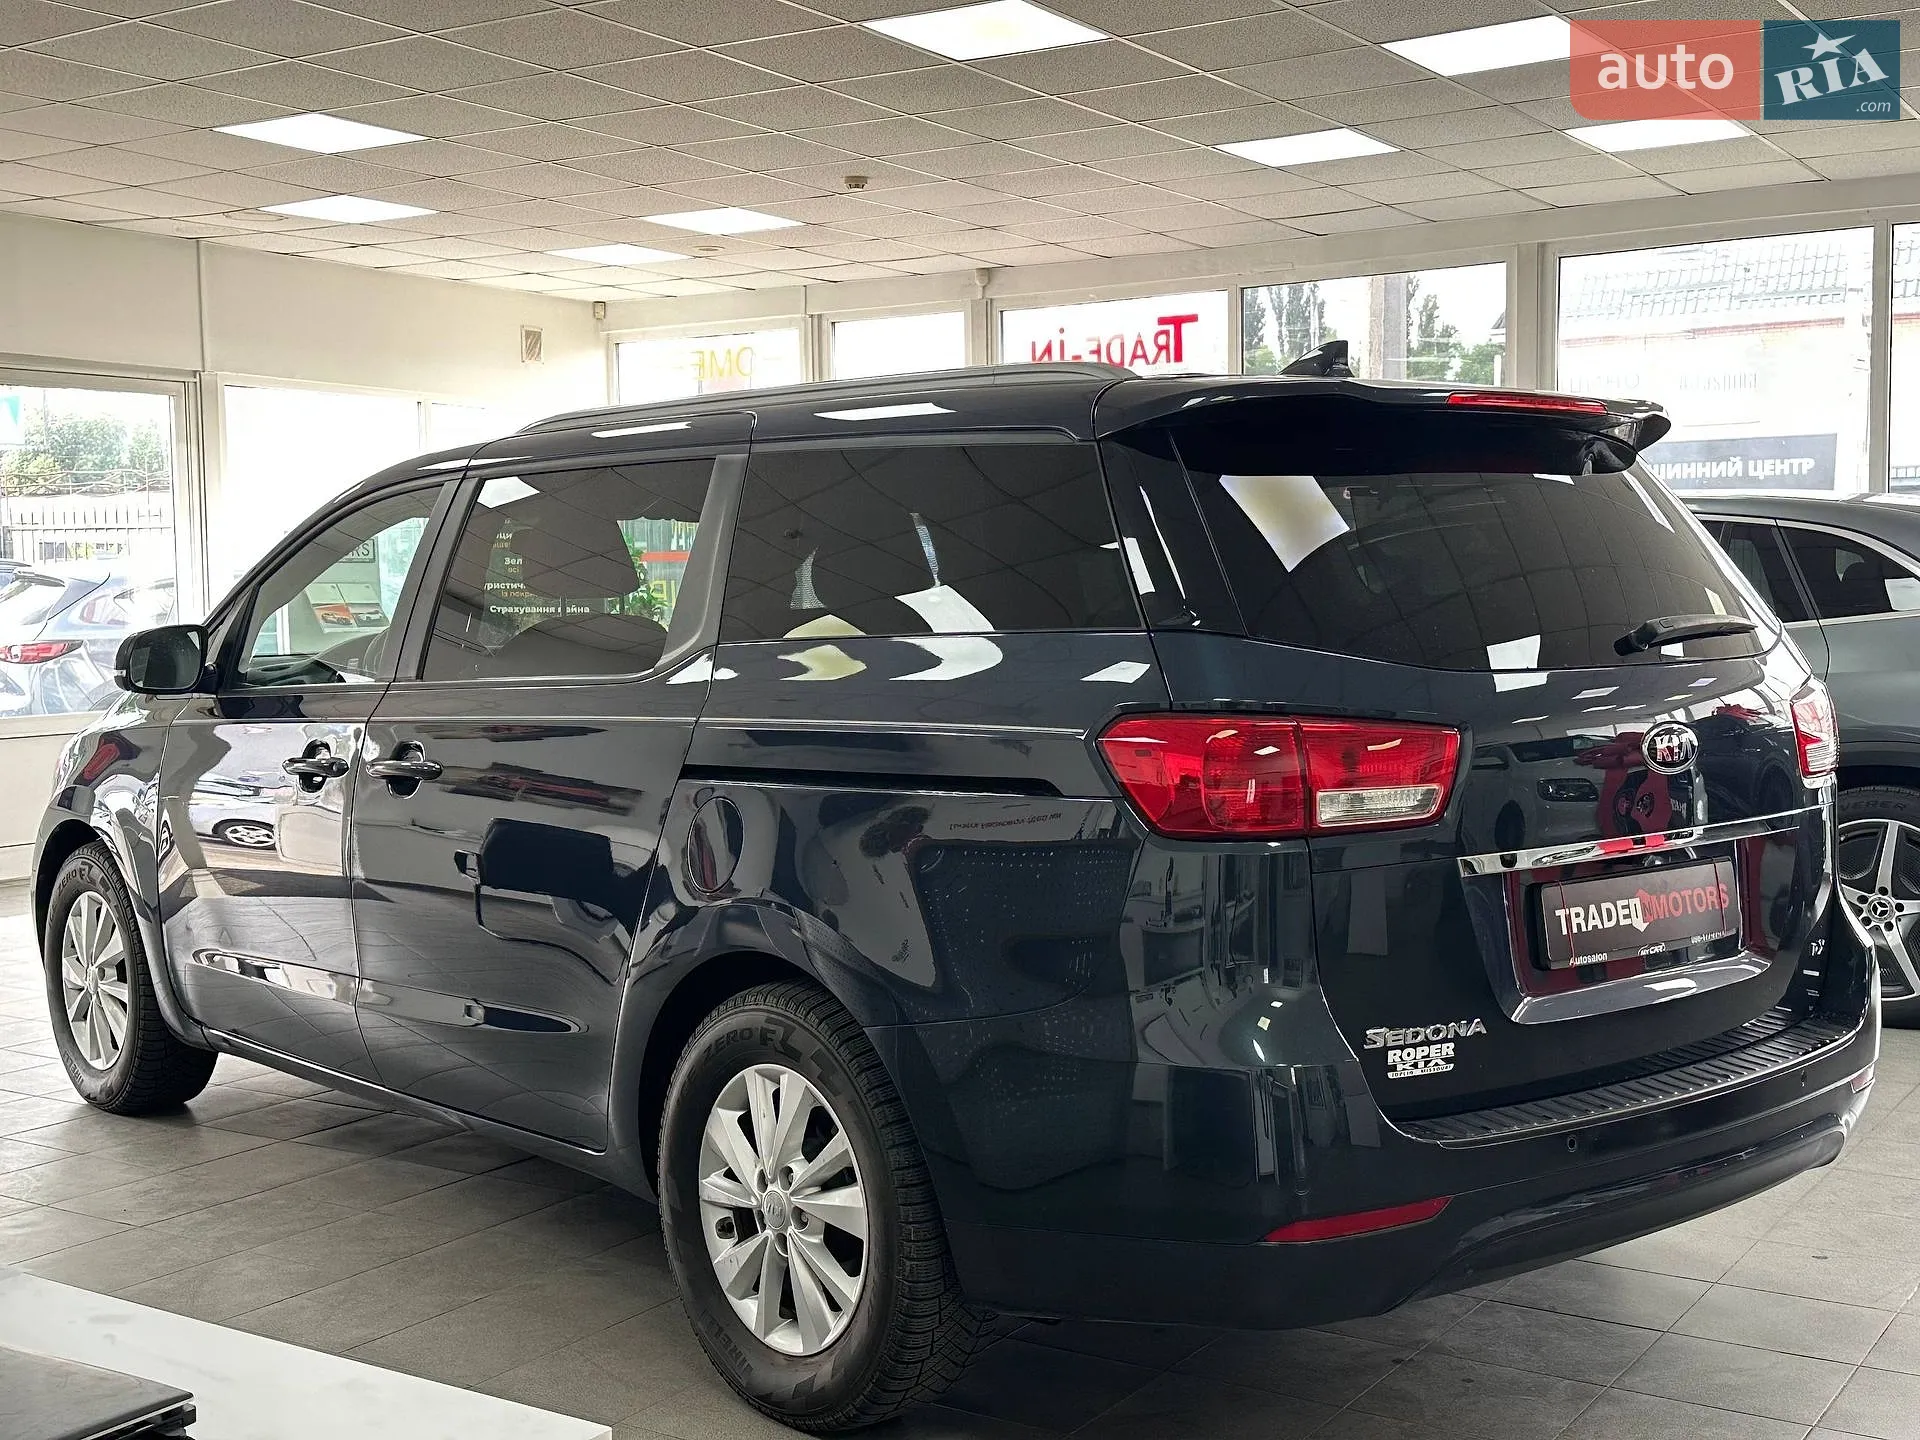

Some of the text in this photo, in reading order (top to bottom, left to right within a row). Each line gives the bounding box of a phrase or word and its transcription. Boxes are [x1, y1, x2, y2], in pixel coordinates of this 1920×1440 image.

[1748, 457, 1816, 480] ЦЕНТР
[1654, 733, 1692, 762] KIA
[1569, 952, 1608, 966] Autosalon
[1363, 1018, 1488, 1050] SEDONA
[1387, 1042, 1456, 1064] ROPER
[1396, 1058, 1447, 1072] KIA
